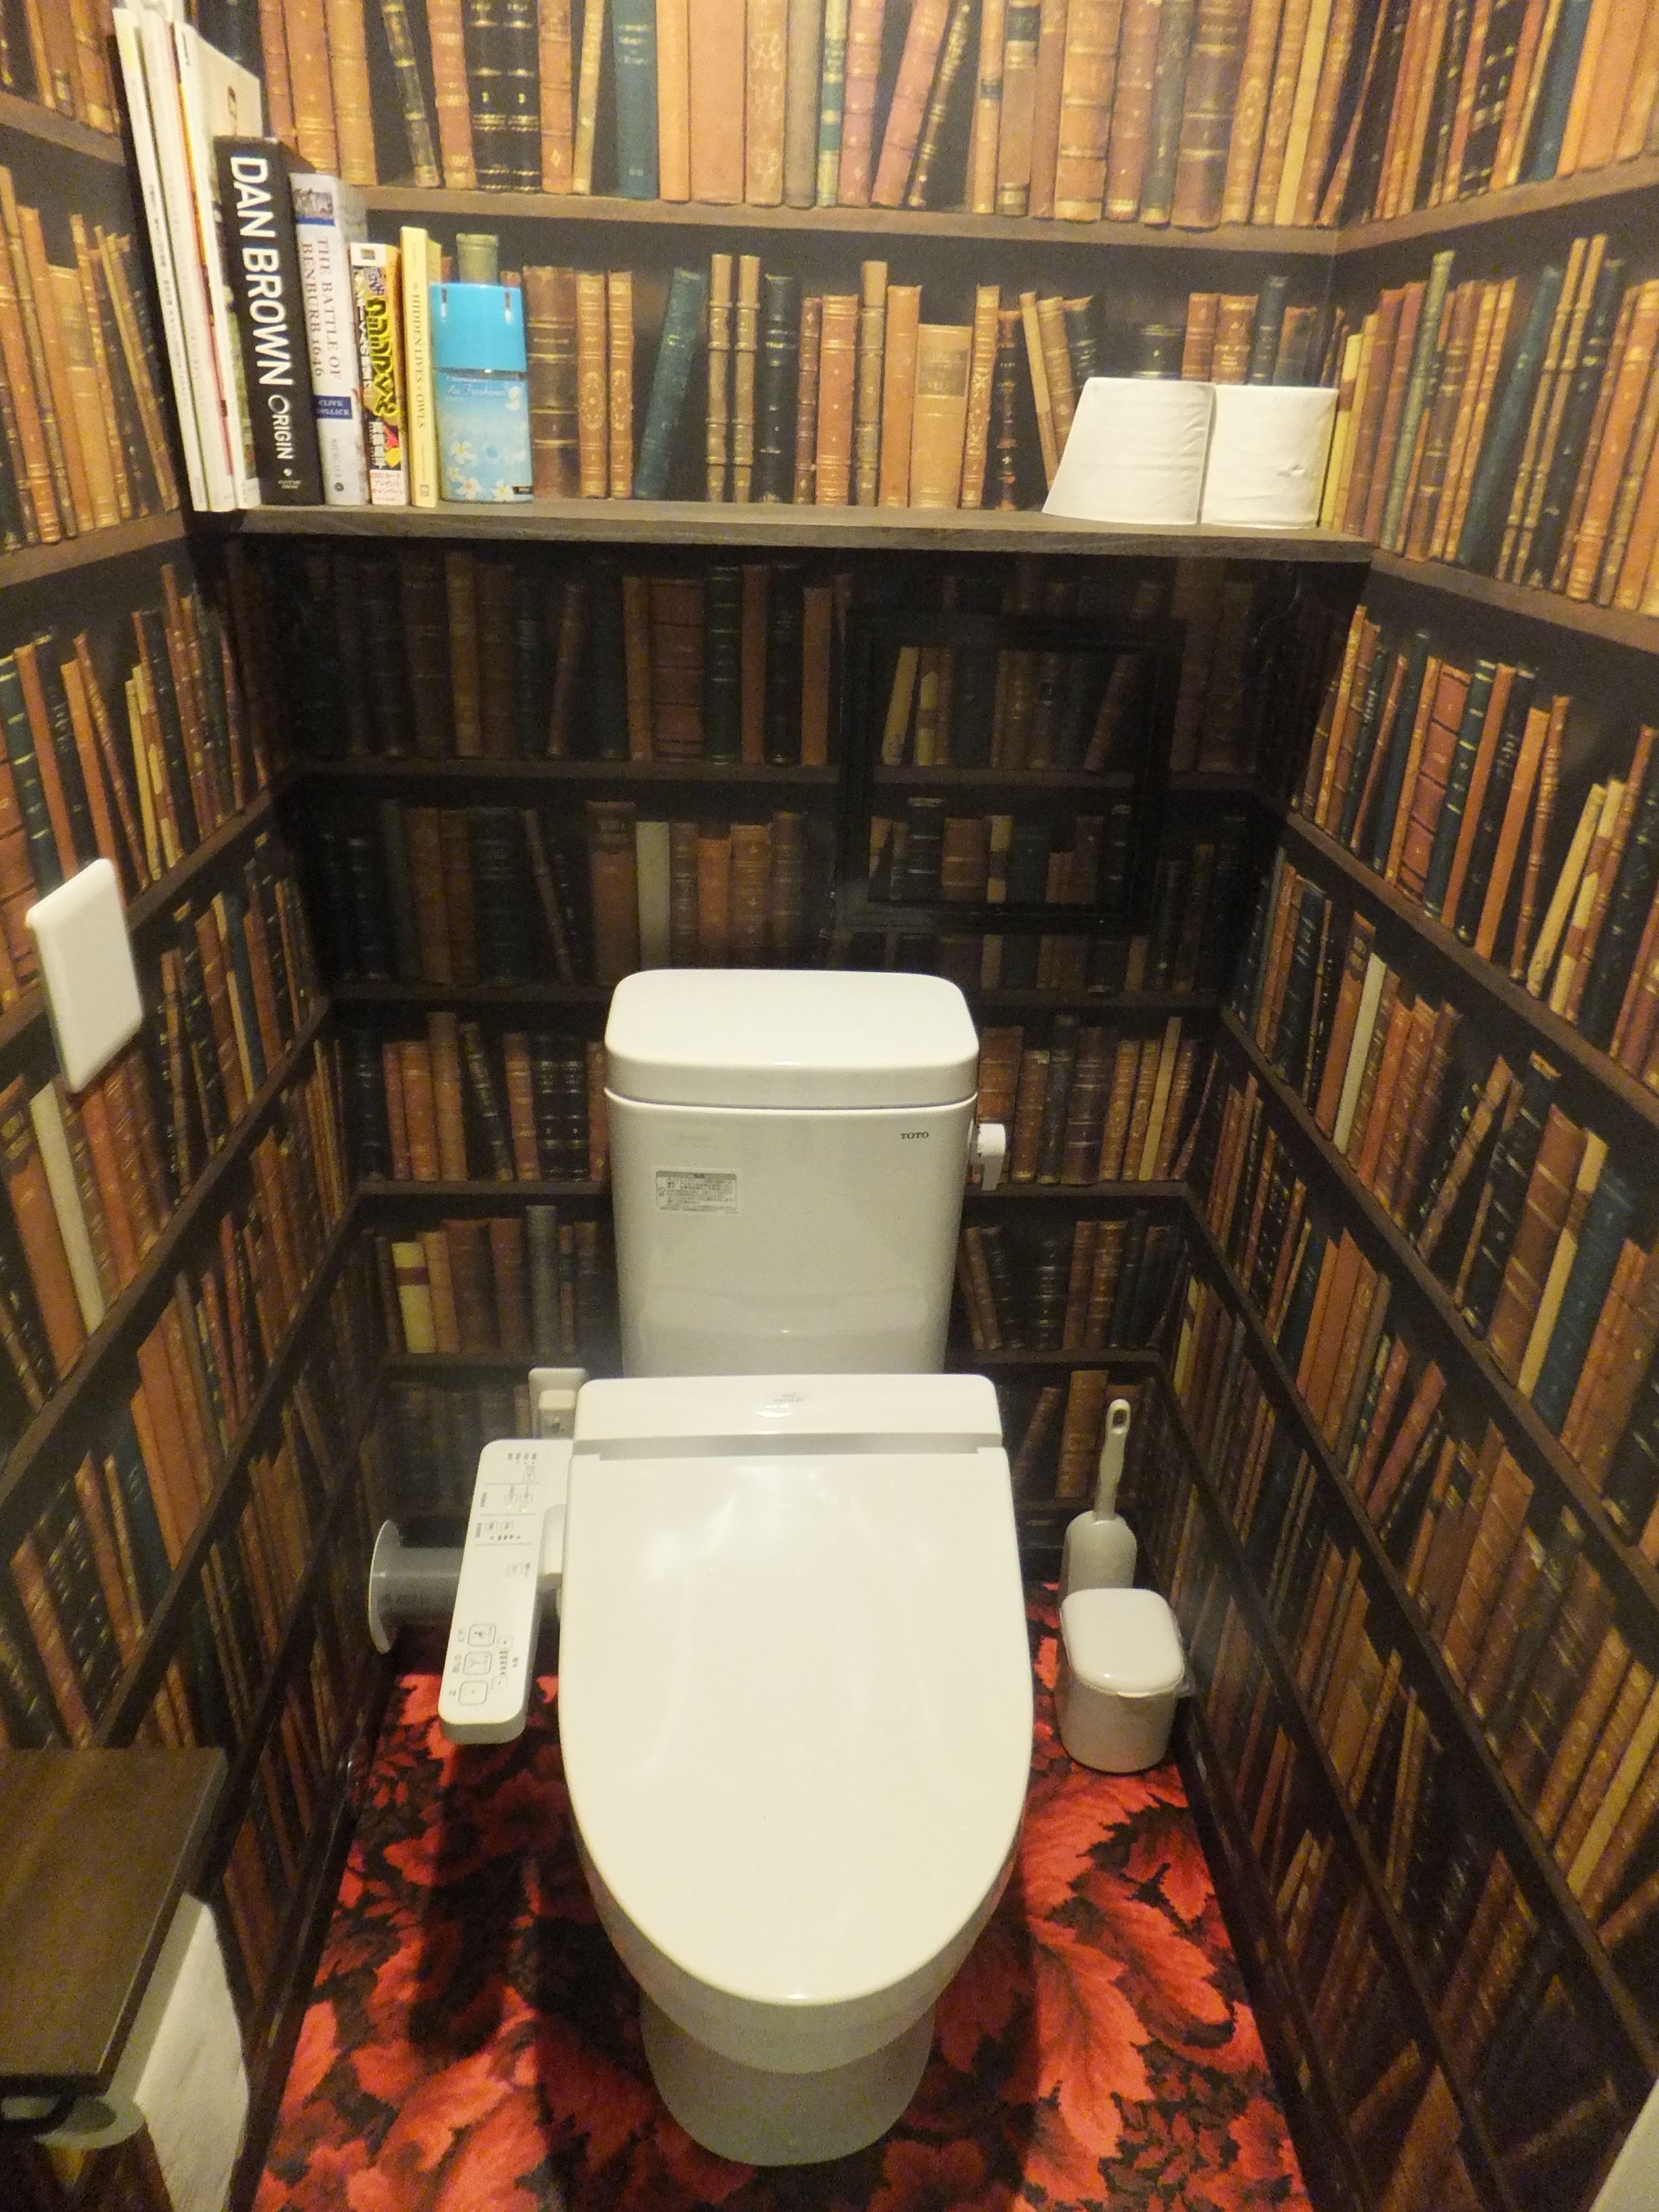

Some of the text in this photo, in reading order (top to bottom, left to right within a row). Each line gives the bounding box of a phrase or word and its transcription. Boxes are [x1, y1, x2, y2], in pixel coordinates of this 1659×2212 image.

[230, 157, 294, 386] DAN BROWN
[302, 243, 321, 332] BENBURB
[318, 238, 342, 380] THE BATTLE OF
[411, 294, 423, 346] HIDDEN
[414, 350, 424, 382] LIVES
[268, 394, 294, 459] ORIGIN
[416, 394, 426, 428] OWLS
[900, 1131, 929, 1139] TOTO
